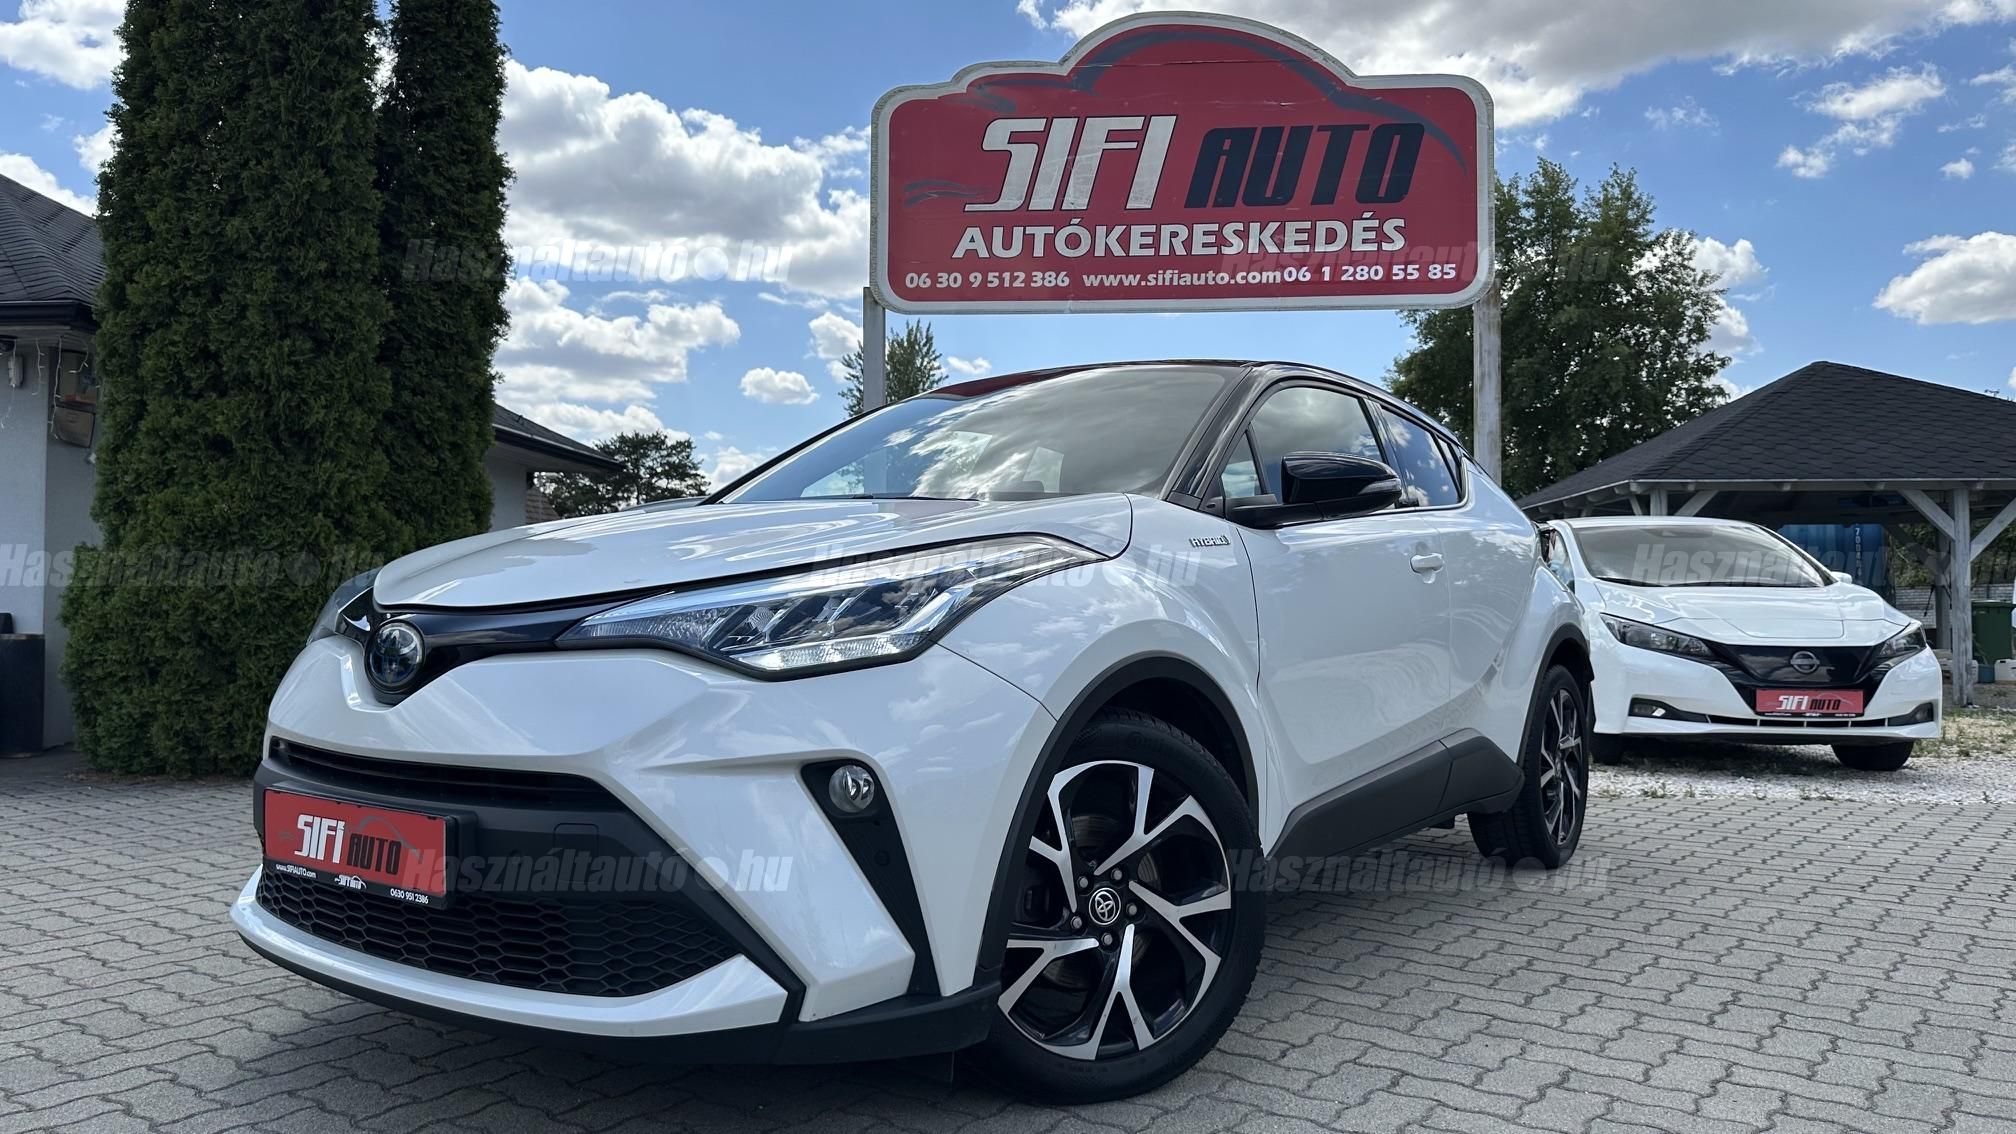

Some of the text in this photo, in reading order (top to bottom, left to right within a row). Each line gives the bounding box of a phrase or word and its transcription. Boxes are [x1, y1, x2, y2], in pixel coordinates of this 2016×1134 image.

[964, 114, 1425, 212] SIFI AUTO
[951, 211, 1408, 259] AUTÓKERESKEDÉS
[905, 271, 932, 288] 06
[936, 272, 962, 288] 30
[1030, 271, 1070, 288] 386
[1082, 268, 1281, 287] www.sifiauto.com
[1283, 263, 1456, 282] 06 1 280 55 85
[1188, 535, 1231, 548] HYBRID
[1776, 695, 1841, 711] SIFI AUTO
[346, 832, 402, 876] AUTO
[390, 888, 405, 899] 0630
[405, 891, 415, 901] 951
